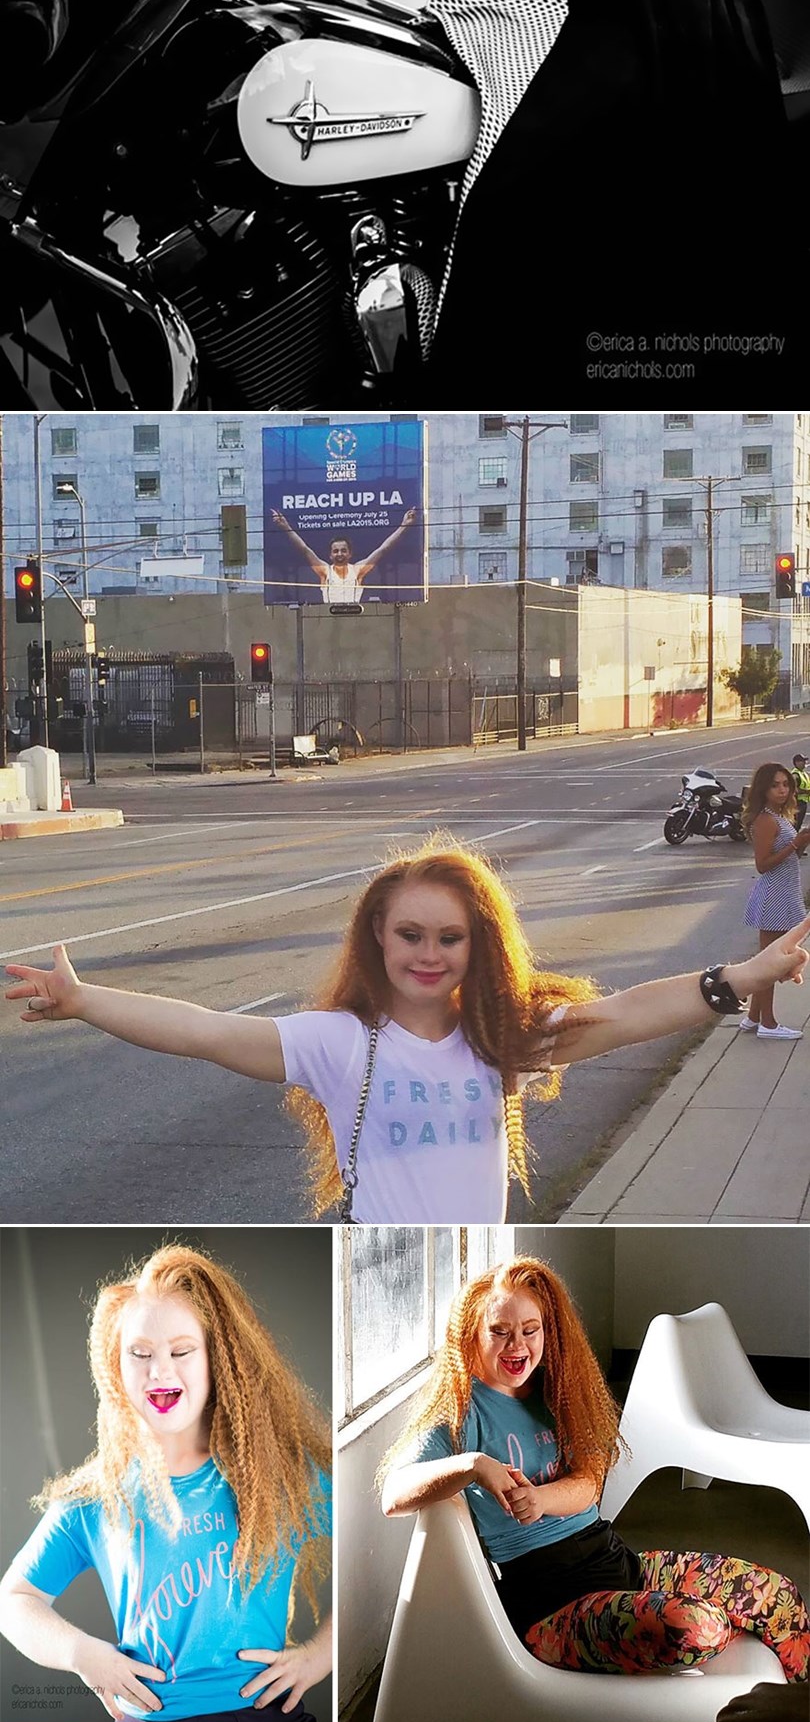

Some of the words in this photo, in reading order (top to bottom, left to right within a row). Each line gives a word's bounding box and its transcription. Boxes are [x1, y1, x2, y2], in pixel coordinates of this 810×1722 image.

[317, 119, 403, 136] HARLEY-DAVIDSON
[326, 470, 357, 479] GAMES
[282, 493, 344, 509] REACH
[348, 491, 375, 506] UP
[379, 490, 404, 505] LA
[299, 513, 327, 522] Opening
[328, 512, 363, 520] Ceremony
[363, 511, 378, 519] July
[378, 510, 389, 518] 25
[298, 521, 321, 529] Tickets
[346, 518, 390, 527] LA2015.ORG
[181, 1511, 227, 1538] RESH
